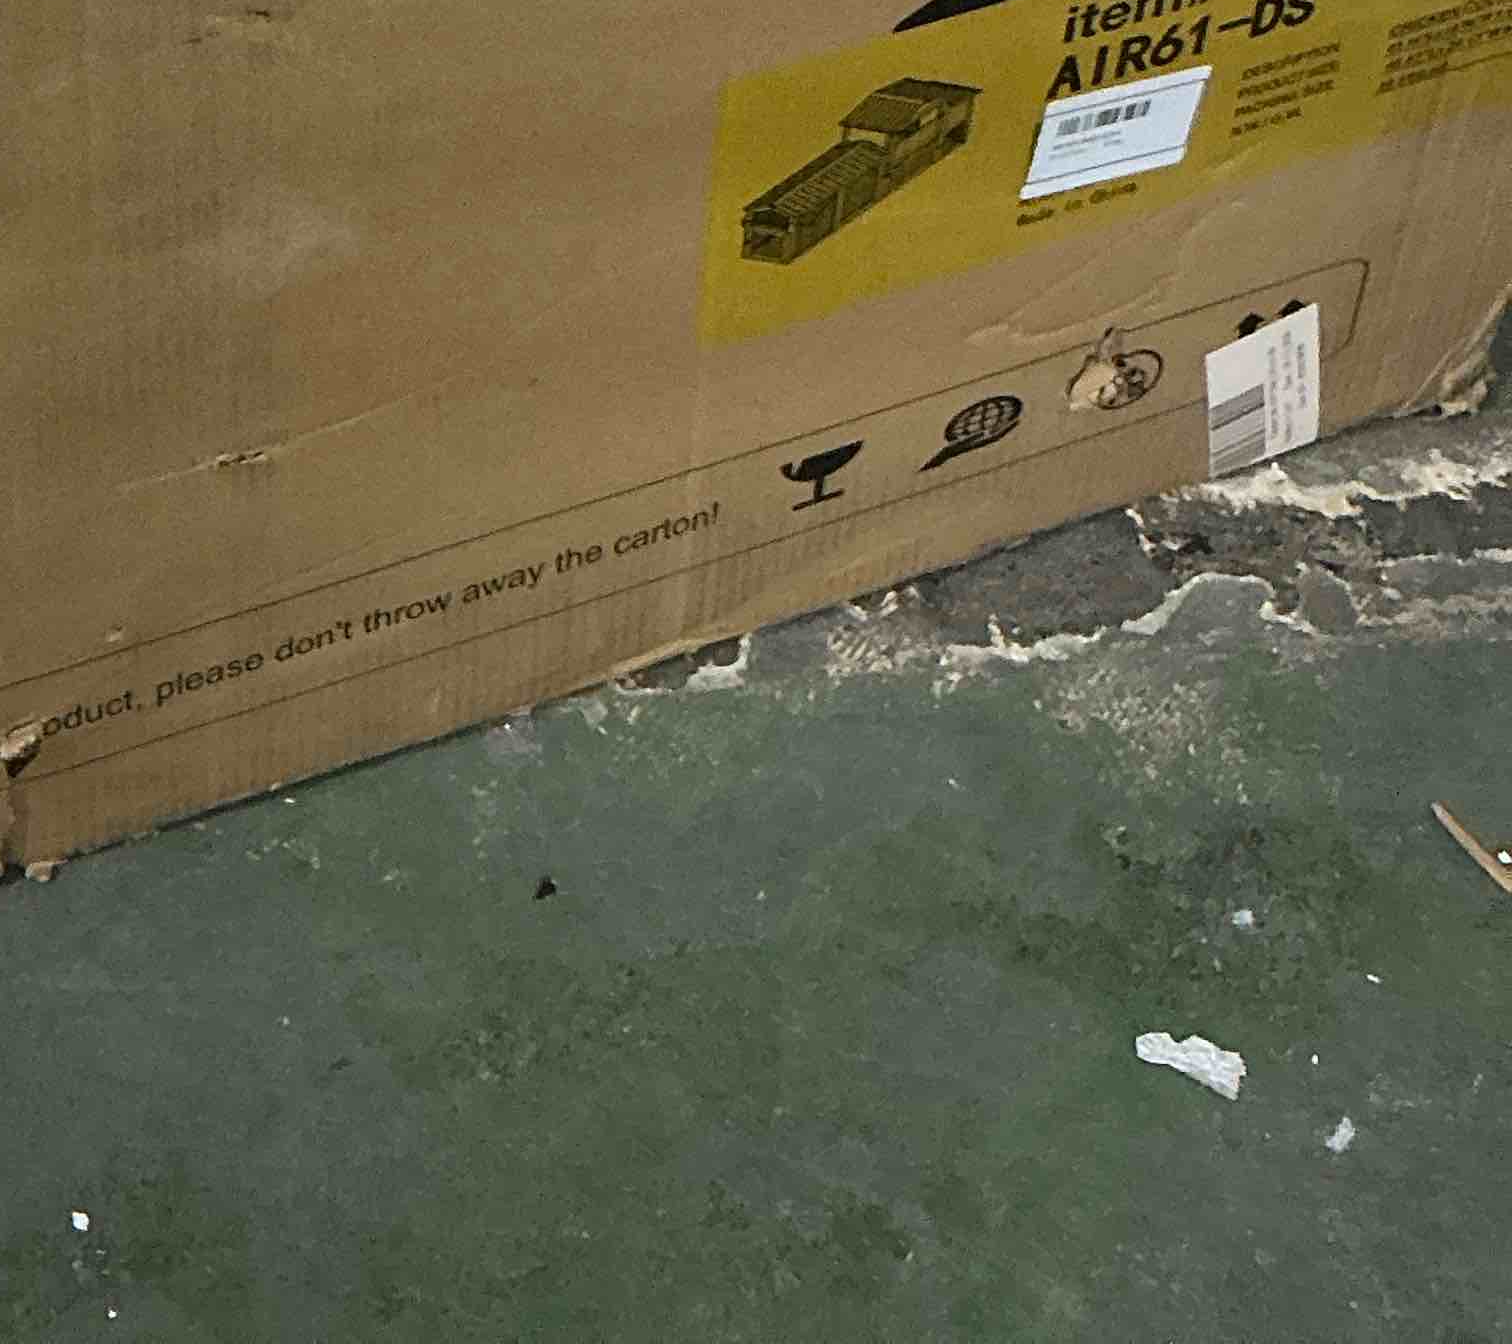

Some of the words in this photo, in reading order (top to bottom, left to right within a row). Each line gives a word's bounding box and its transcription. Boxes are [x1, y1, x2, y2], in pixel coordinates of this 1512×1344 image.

[154, 648, 265, 710] please
[273, 615, 355, 663] don't
[361, 587, 454, 636] throw
[460, 557, 547, 607] away
[553, 541, 605, 575] the
[612, 499, 723, 556] carton!
